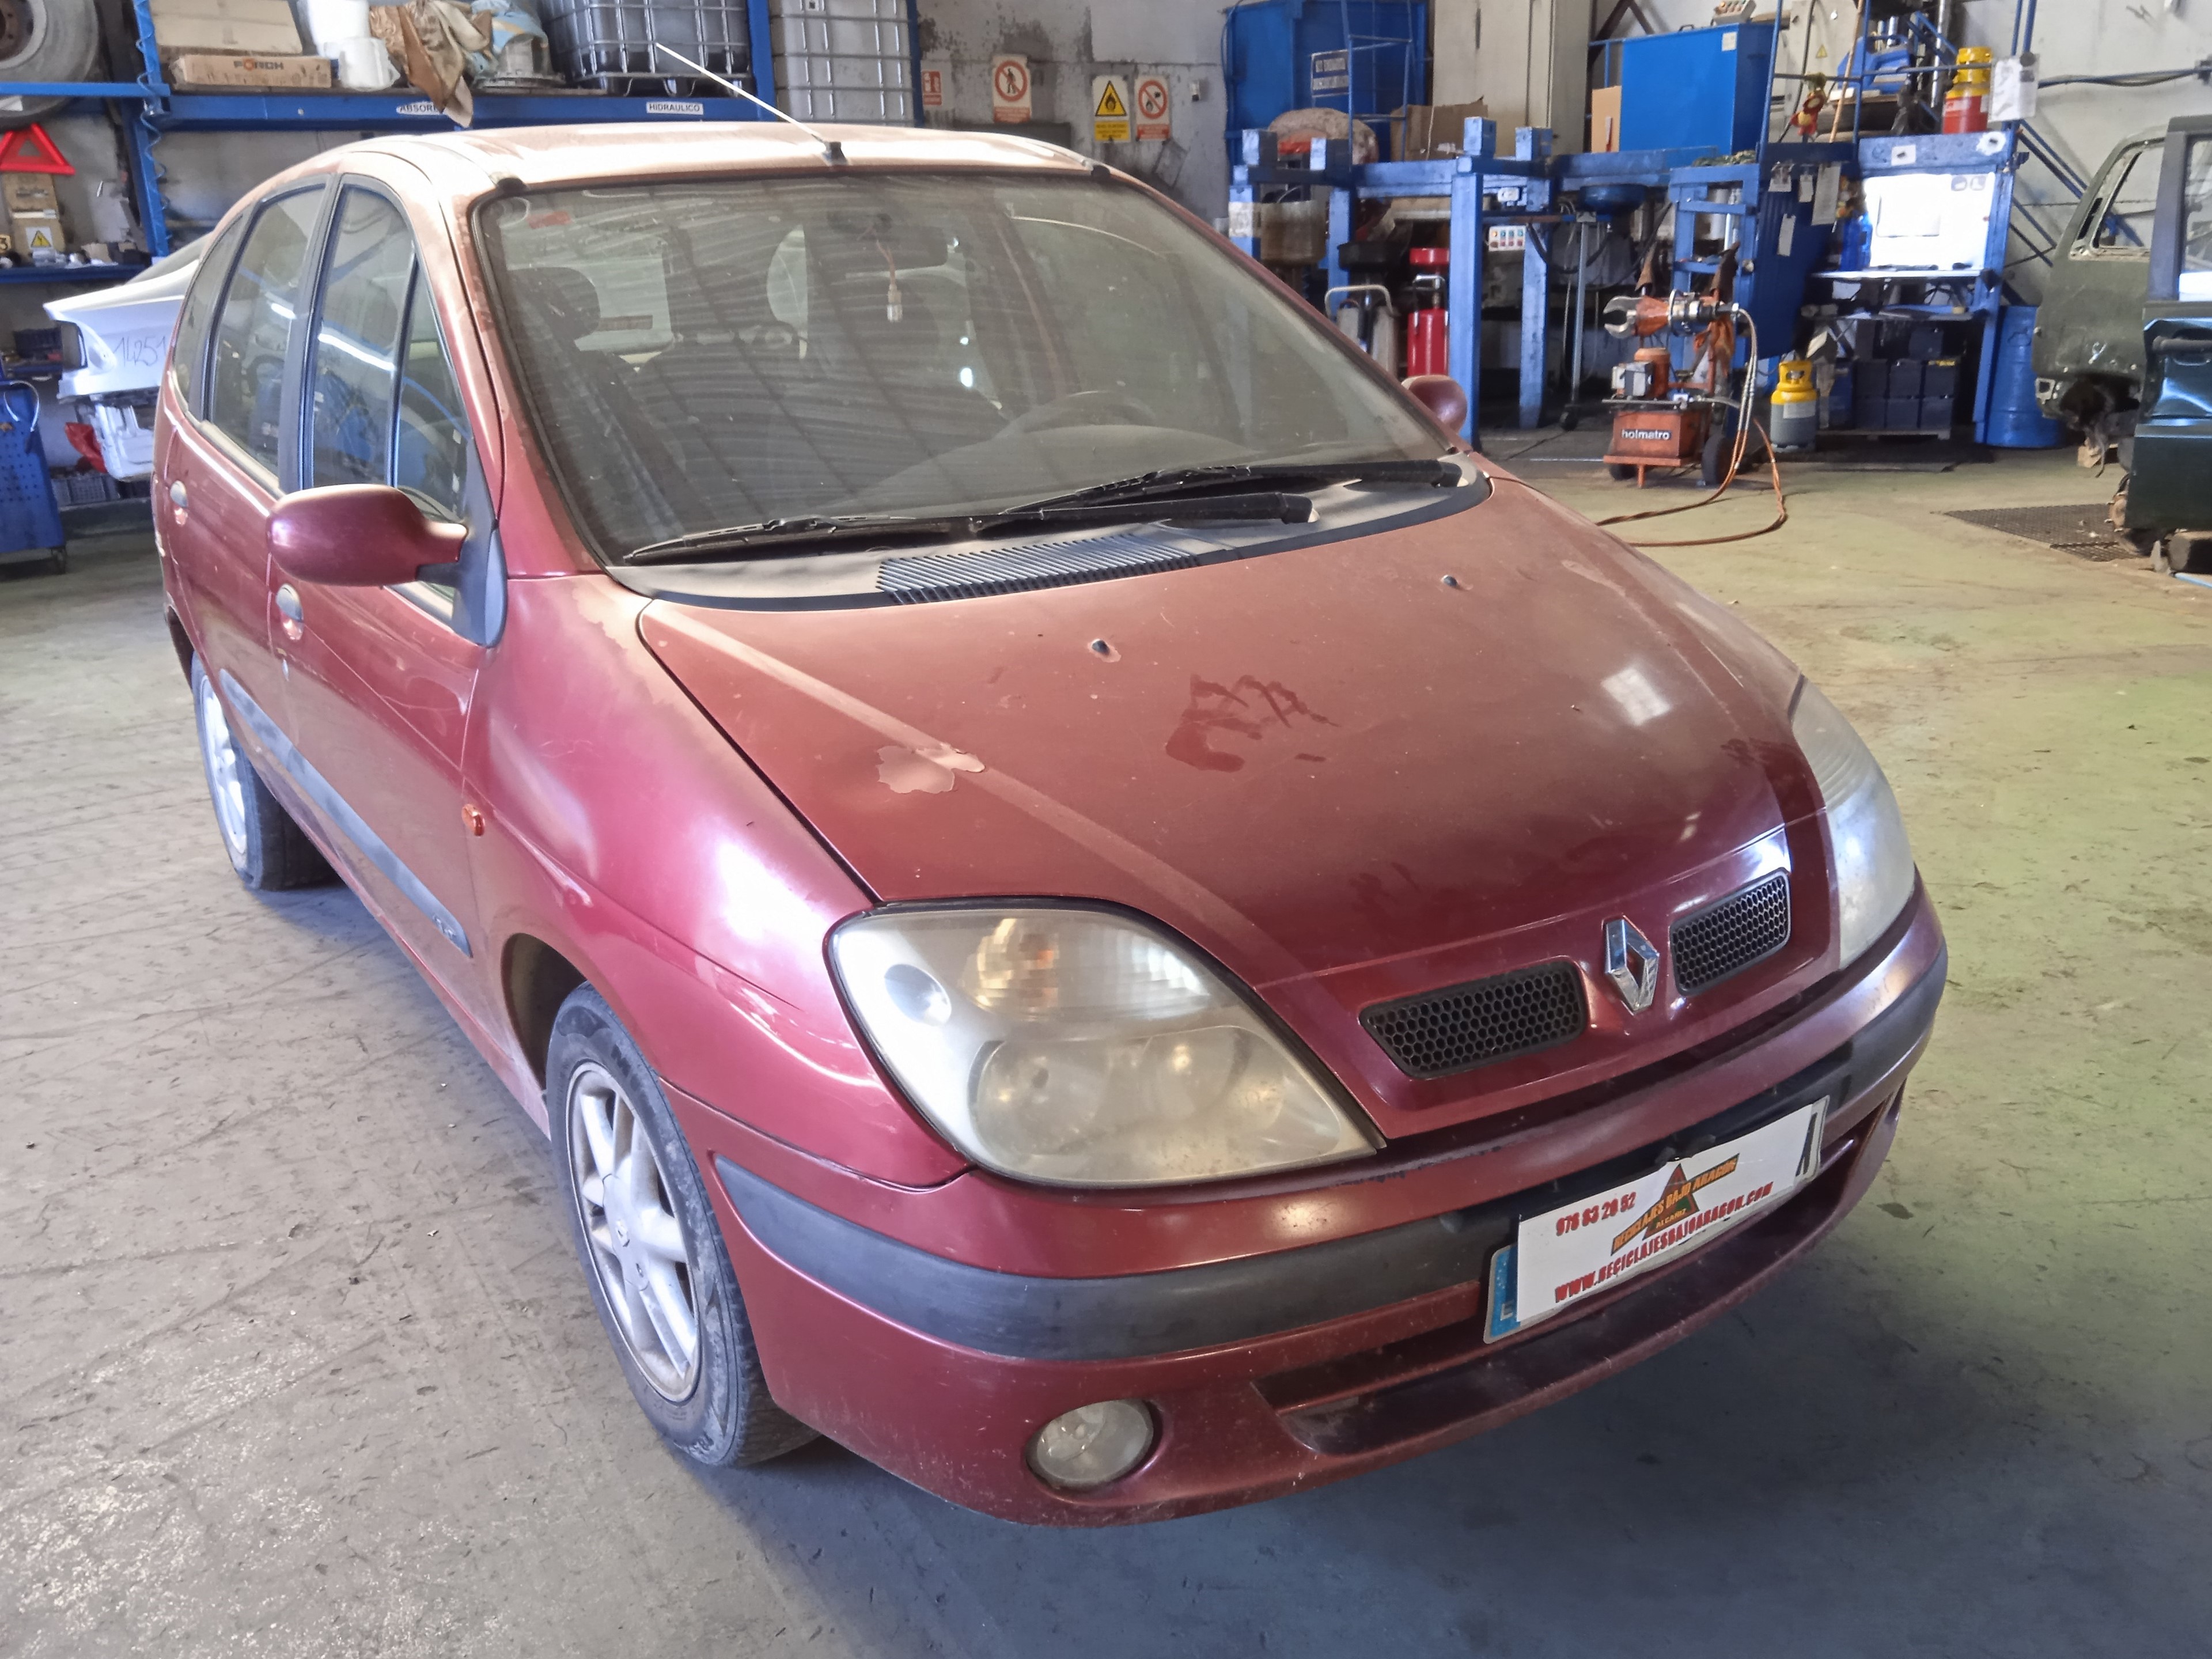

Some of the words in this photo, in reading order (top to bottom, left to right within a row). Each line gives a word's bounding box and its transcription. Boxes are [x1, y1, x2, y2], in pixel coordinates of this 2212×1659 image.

[649, 104, 700, 112] HIDRAULICO
[1622, 429, 1670, 440] holmatro
[1620, 1192, 1636, 1212] 52
[1614, 1199, 1664, 1251] RECICLAJES
[1665, 1182, 1691, 1209] BAJO
